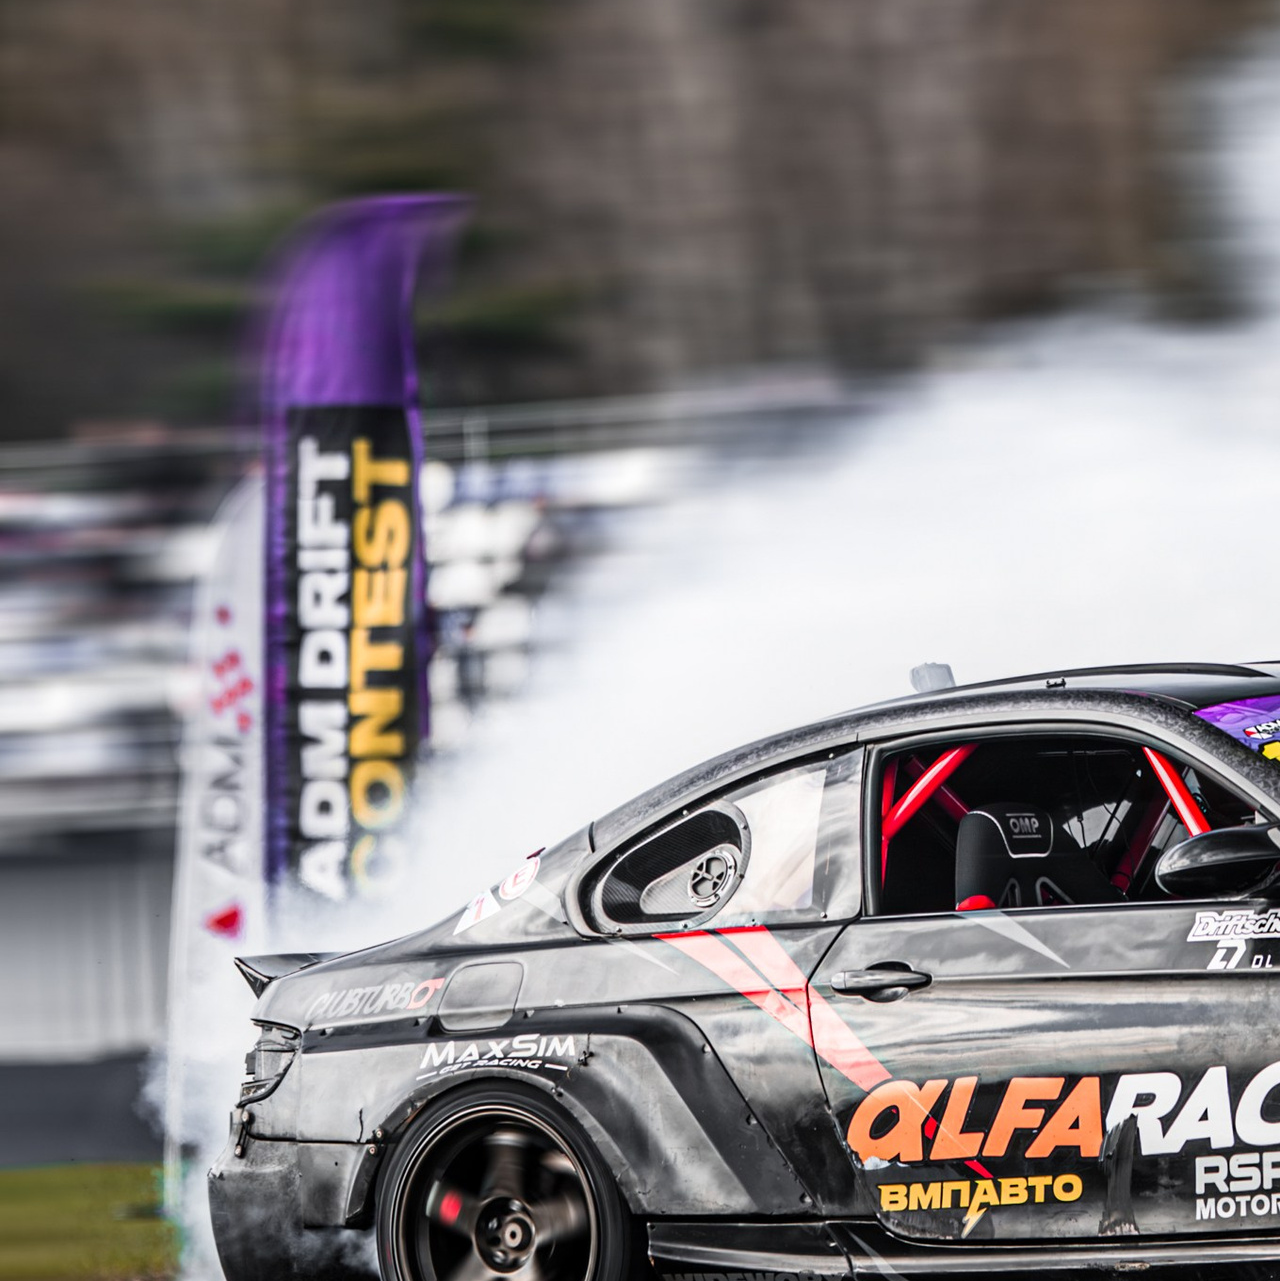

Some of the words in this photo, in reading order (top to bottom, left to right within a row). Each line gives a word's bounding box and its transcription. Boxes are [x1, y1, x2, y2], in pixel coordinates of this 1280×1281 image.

[296, 436, 350, 688] DRIFT
[298, 700, 350, 901] ADM
[1009, 817, 1039, 833] OMP
[1251, 954, 1273, 969] DL
[439, 1061, 469, 1075] GET
[472, 1058, 543, 1070] RACING
[877, 1174, 1084, 1217] ВМПАВТО
